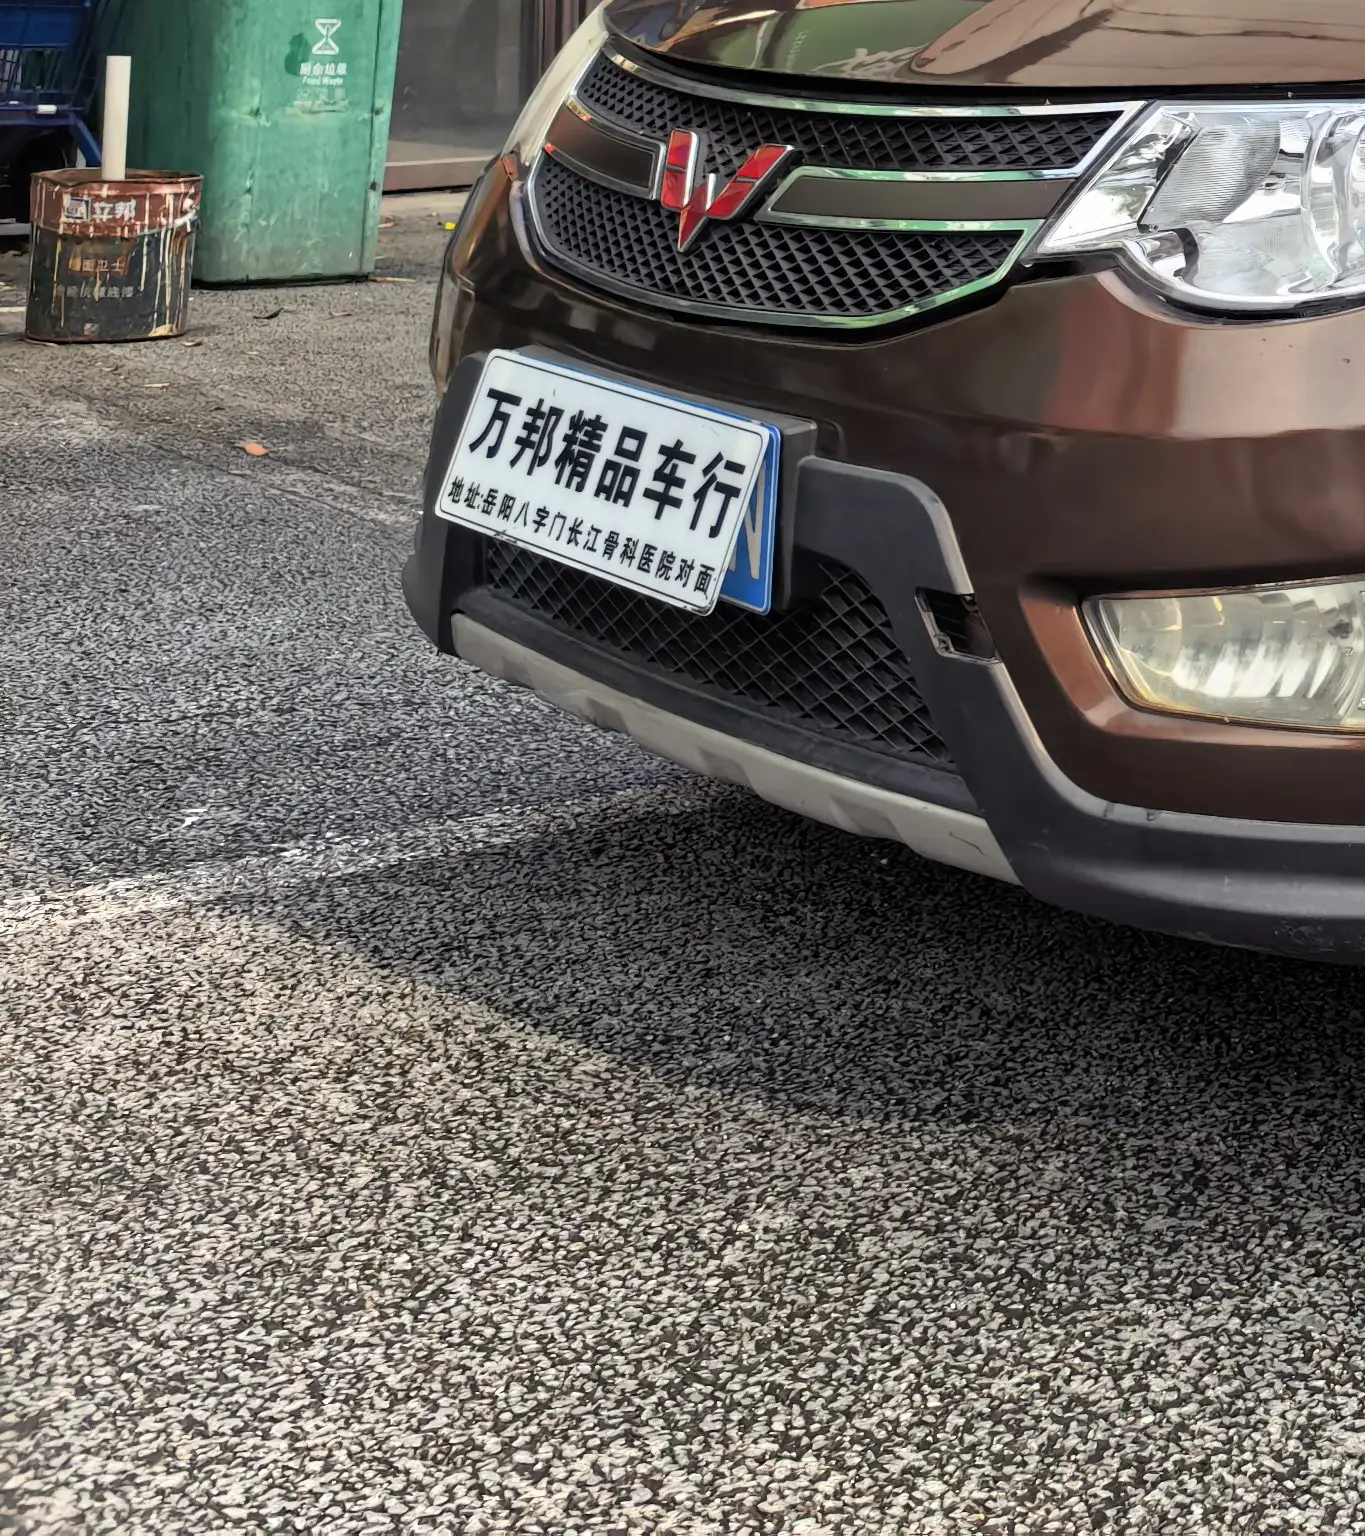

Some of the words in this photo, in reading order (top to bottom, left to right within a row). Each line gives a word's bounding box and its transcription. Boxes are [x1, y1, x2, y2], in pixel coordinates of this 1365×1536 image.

[469, 387, 747, 540] 万邦精品车行
